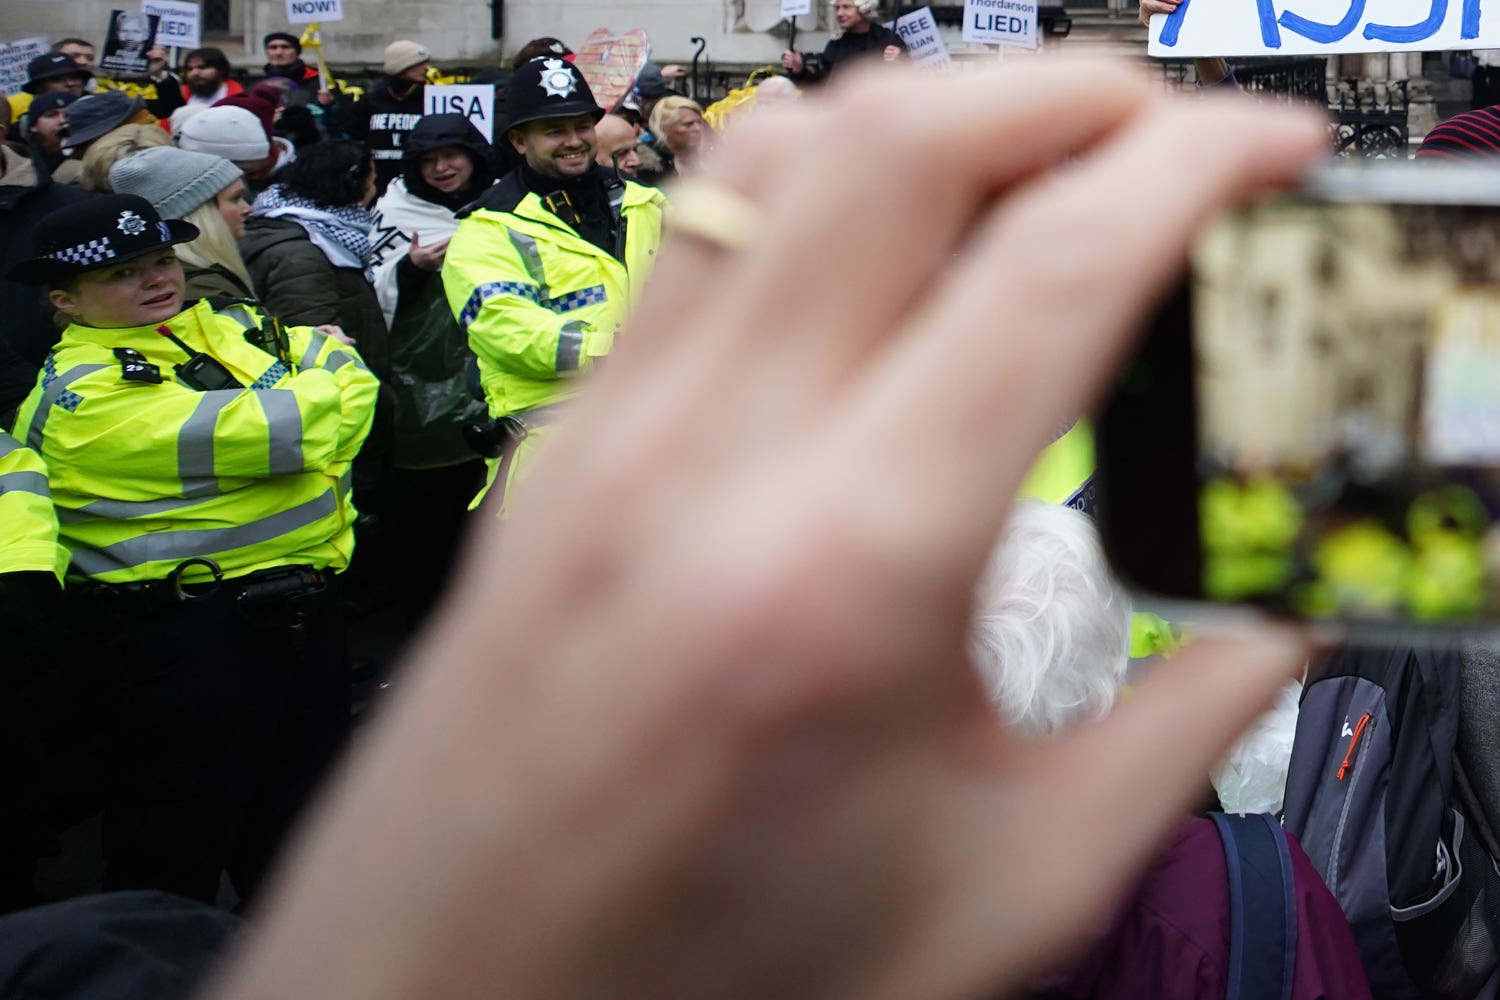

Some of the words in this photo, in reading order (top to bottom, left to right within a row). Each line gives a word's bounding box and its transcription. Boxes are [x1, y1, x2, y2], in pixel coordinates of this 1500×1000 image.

[292, 0, 337, 15] NOW!
[160, 20, 193, 37] IED!
[899, 16, 931, 38] REE
[974, 12, 1028, 36] LIED!
[907, 34, 936, 50] LIAN
[431, 95, 485, 121] USA
